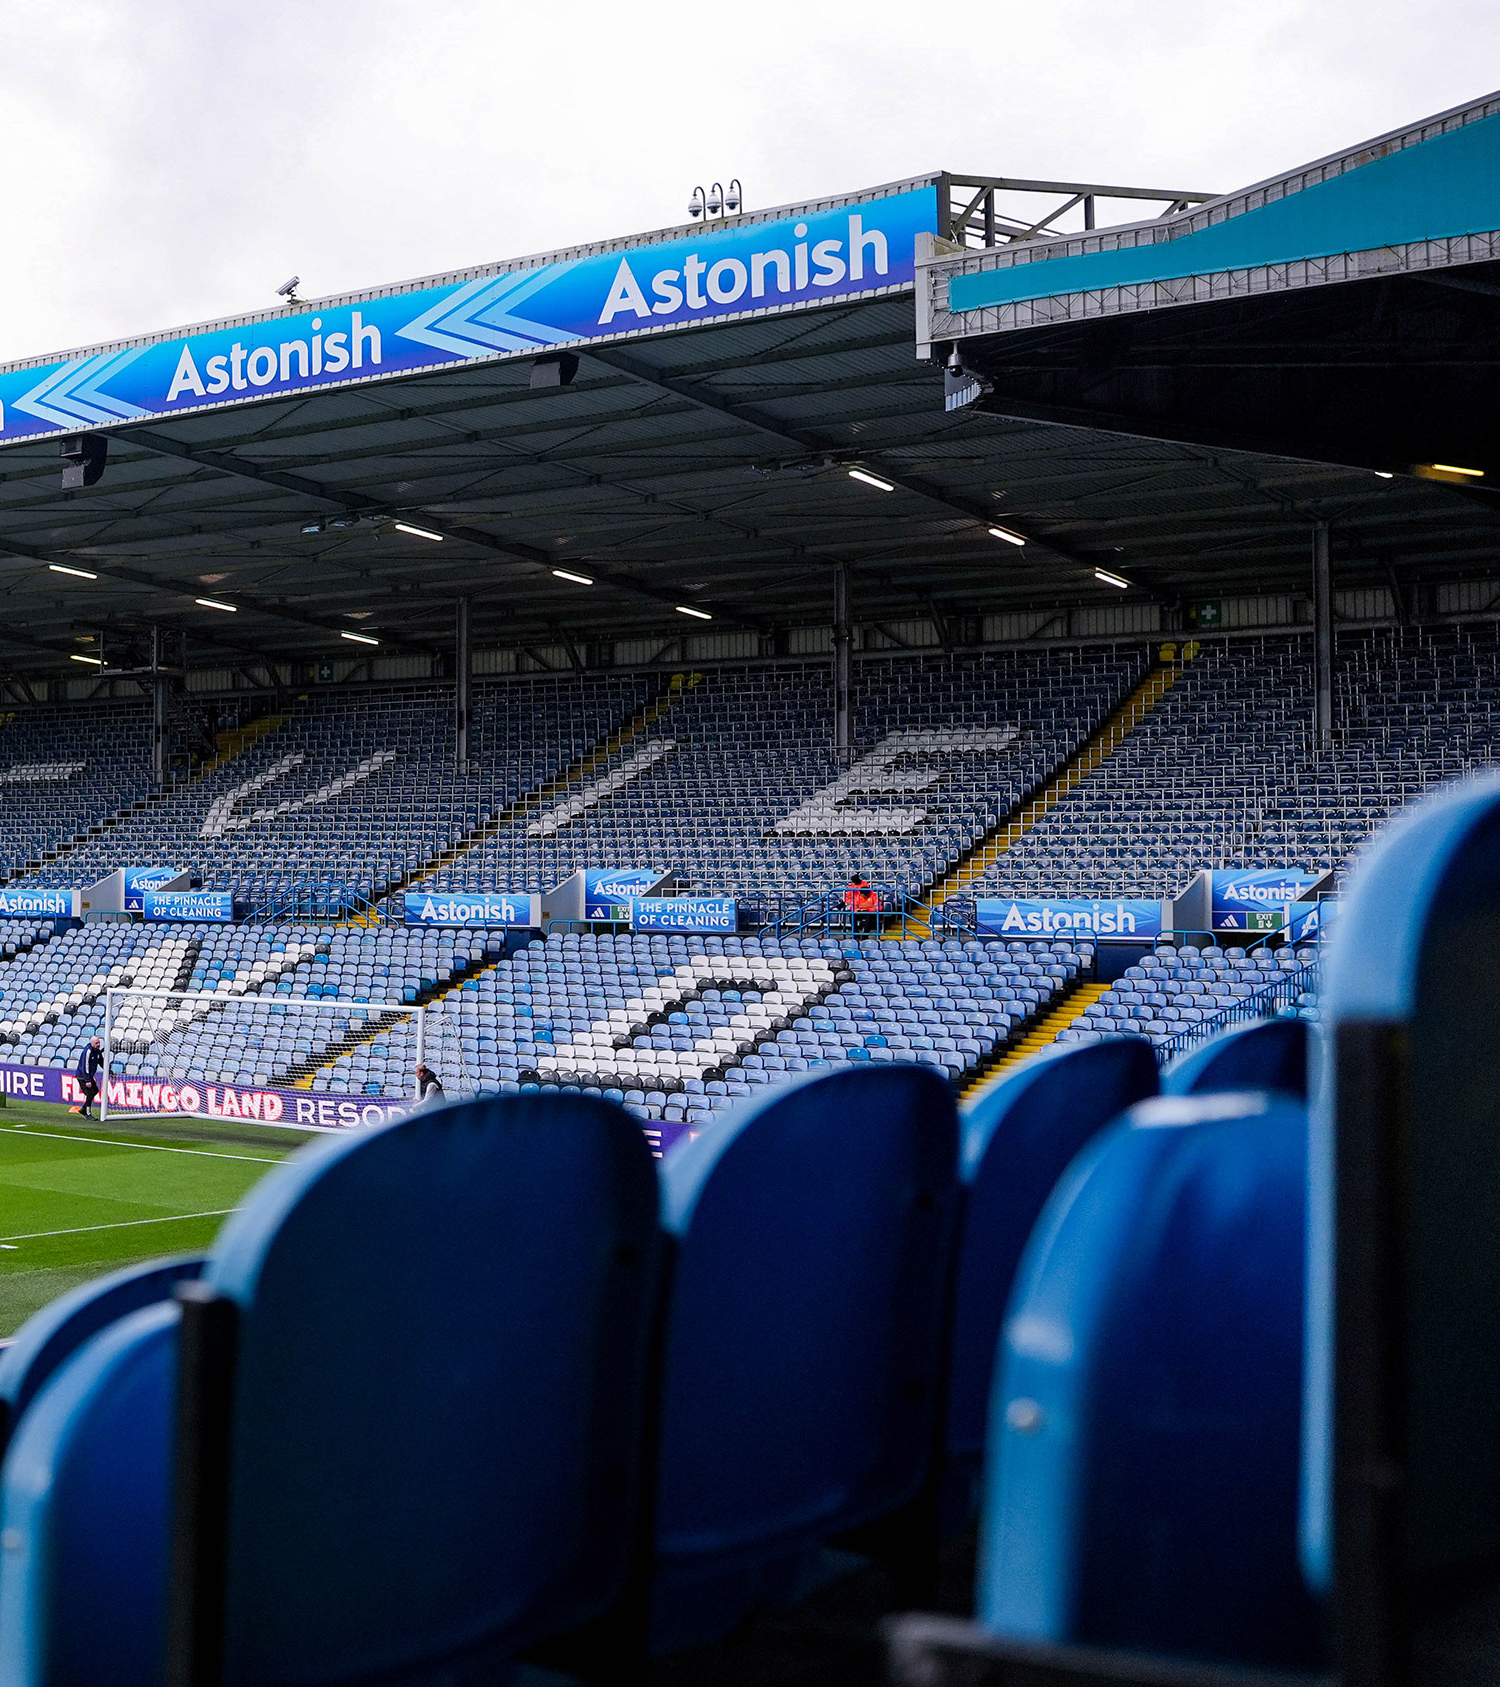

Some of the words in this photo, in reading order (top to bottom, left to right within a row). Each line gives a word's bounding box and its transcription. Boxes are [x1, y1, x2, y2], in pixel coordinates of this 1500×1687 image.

[597, 214, 889, 325] Astonish
[166, 311, 382, 402] Astonish
[153, 896, 171, 905] THE
[174, 896, 222, 906] PINNACLE
[153, 907, 167, 917] OF
[169, 907, 222, 917] CLEANING
[420, 897, 515, 923] Astonish
[638, 902, 661, 913] THE
[666, 902, 730, 914] PINNACLE
[638, 914, 658, 925] OF
[660, 915, 730, 926] CLEANING
[1001, 903, 1135, 933] Astonish
[60, 1074, 200, 1113] FLMINGO
[206, 1086, 284, 1121] LAND
